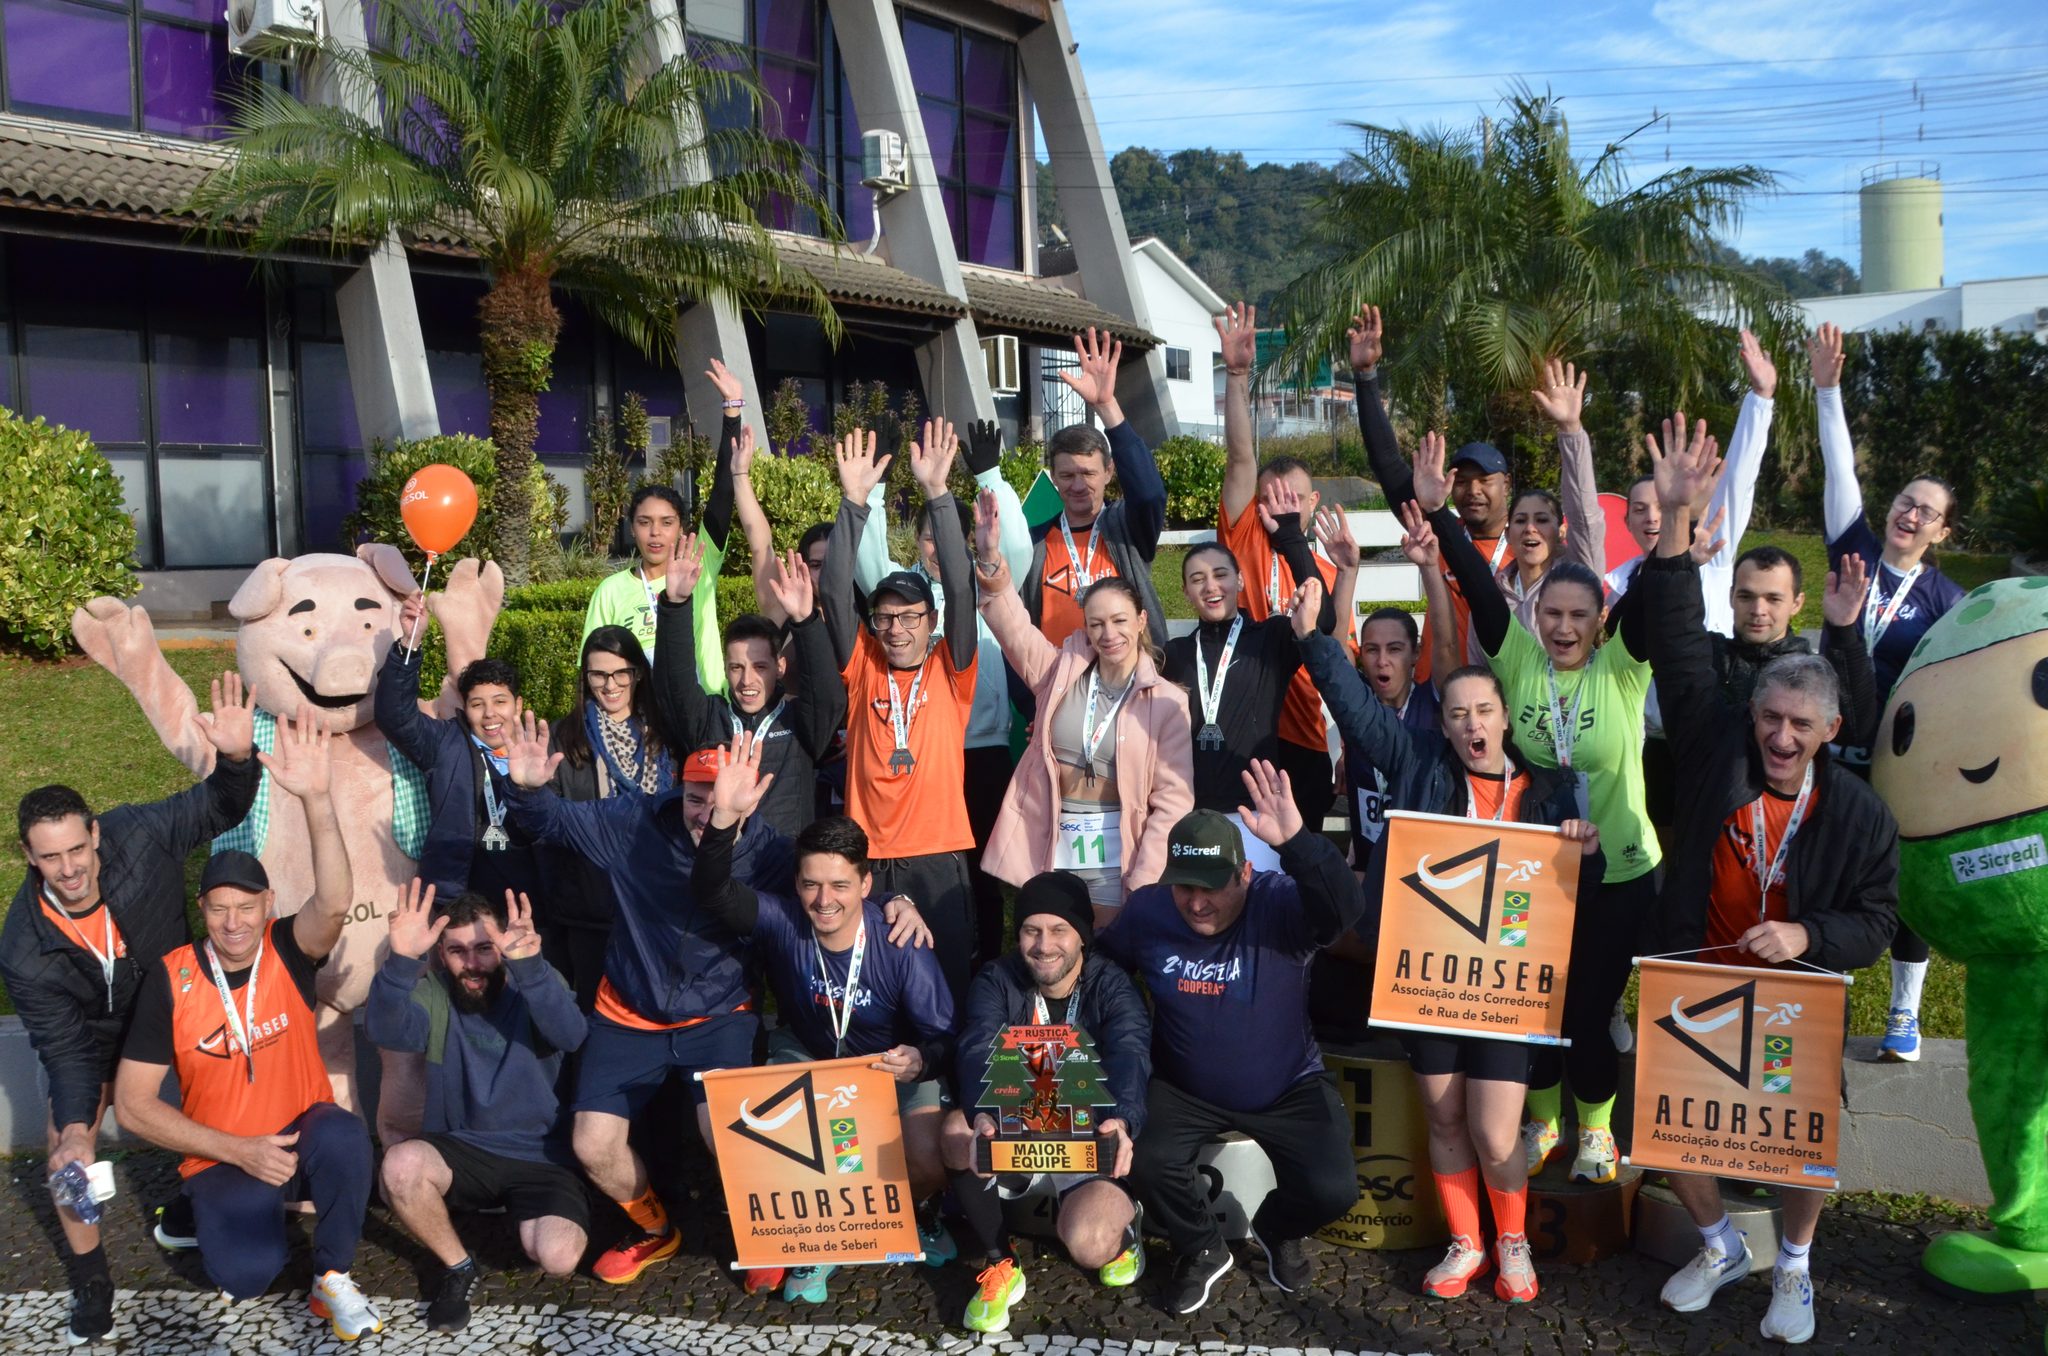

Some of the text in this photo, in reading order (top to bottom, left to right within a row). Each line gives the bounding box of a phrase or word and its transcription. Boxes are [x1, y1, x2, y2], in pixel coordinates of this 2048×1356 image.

[1072, 834, 1106, 864] 11
[1182, 844, 1221, 856] Sicredi
[1978, 843, 2041, 871] Sicredi
[1395, 948, 1554, 994] ACORSEB
[1391, 983, 1551, 1010] Associação dos Corredores
[1418, 1005, 1519, 1025] de Rua de Seberi
[228, 1012, 289, 1051] ARSEB
[1025, 1027, 1069, 1038] RÚSTICA
[994, 1085, 1021, 1094] creluz
[1655, 1094, 1824, 1144] ACORSEB
[1014, 1143, 1067, 1156] MAIOR
[1086, 1144, 1095, 1169] 2026
[1651, 1129, 1823, 1160] Associação dos Corredores
[1011, 1156, 1071, 1169] EQUIPE
[1681, 1153, 1789, 1175] de Rua de Seberi
[1357, 1173, 1415, 1201] esc
[748, 1184, 901, 1221] ACORSEB
[751, 1219, 904, 1238] Associação dos Corredores
[1338, 1212, 1413, 1227] omércio
[1528, 1198, 1568, 1259] 3
[781, 1238, 878, 1253] de Rua de Seberi
